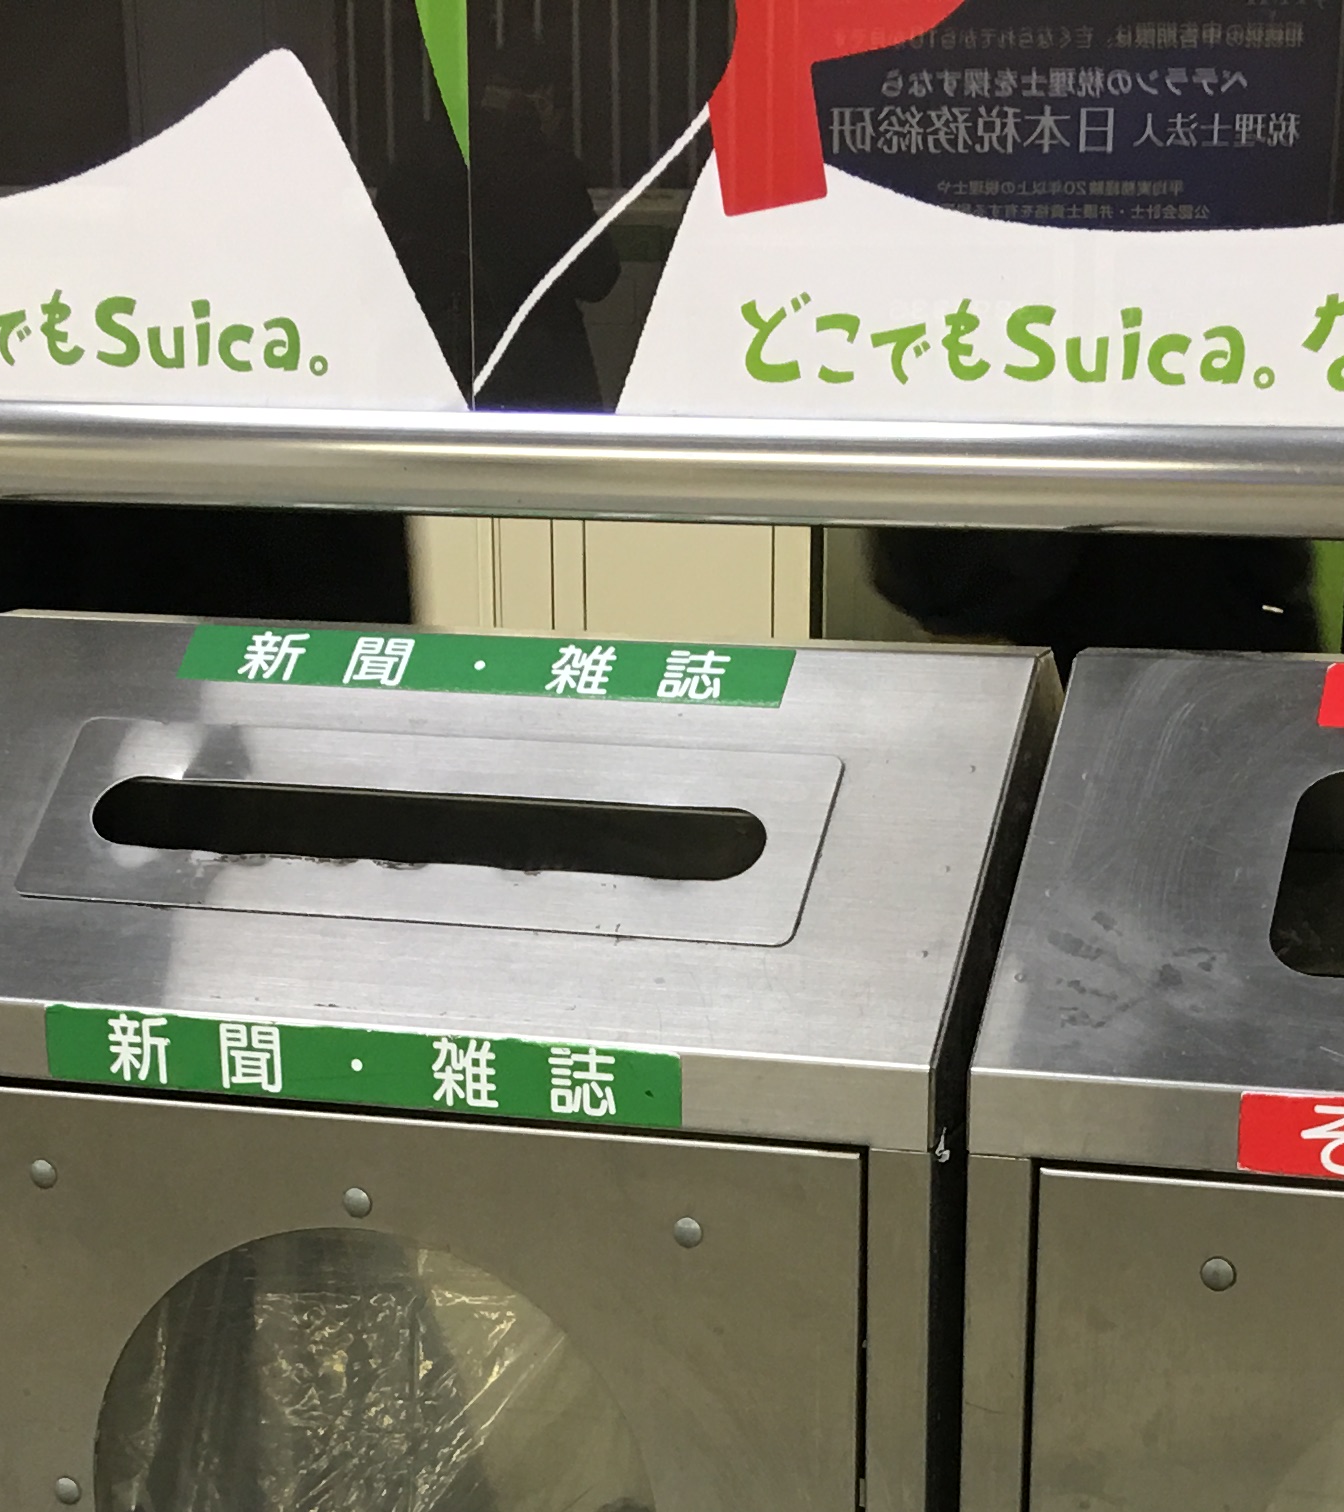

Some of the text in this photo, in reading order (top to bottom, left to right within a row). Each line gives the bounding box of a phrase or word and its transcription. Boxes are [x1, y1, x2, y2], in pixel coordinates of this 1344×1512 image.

[236, 632, 732, 701] 新聞・雑誌
[107, 1014, 617, 1117] 新聞・雑誌
